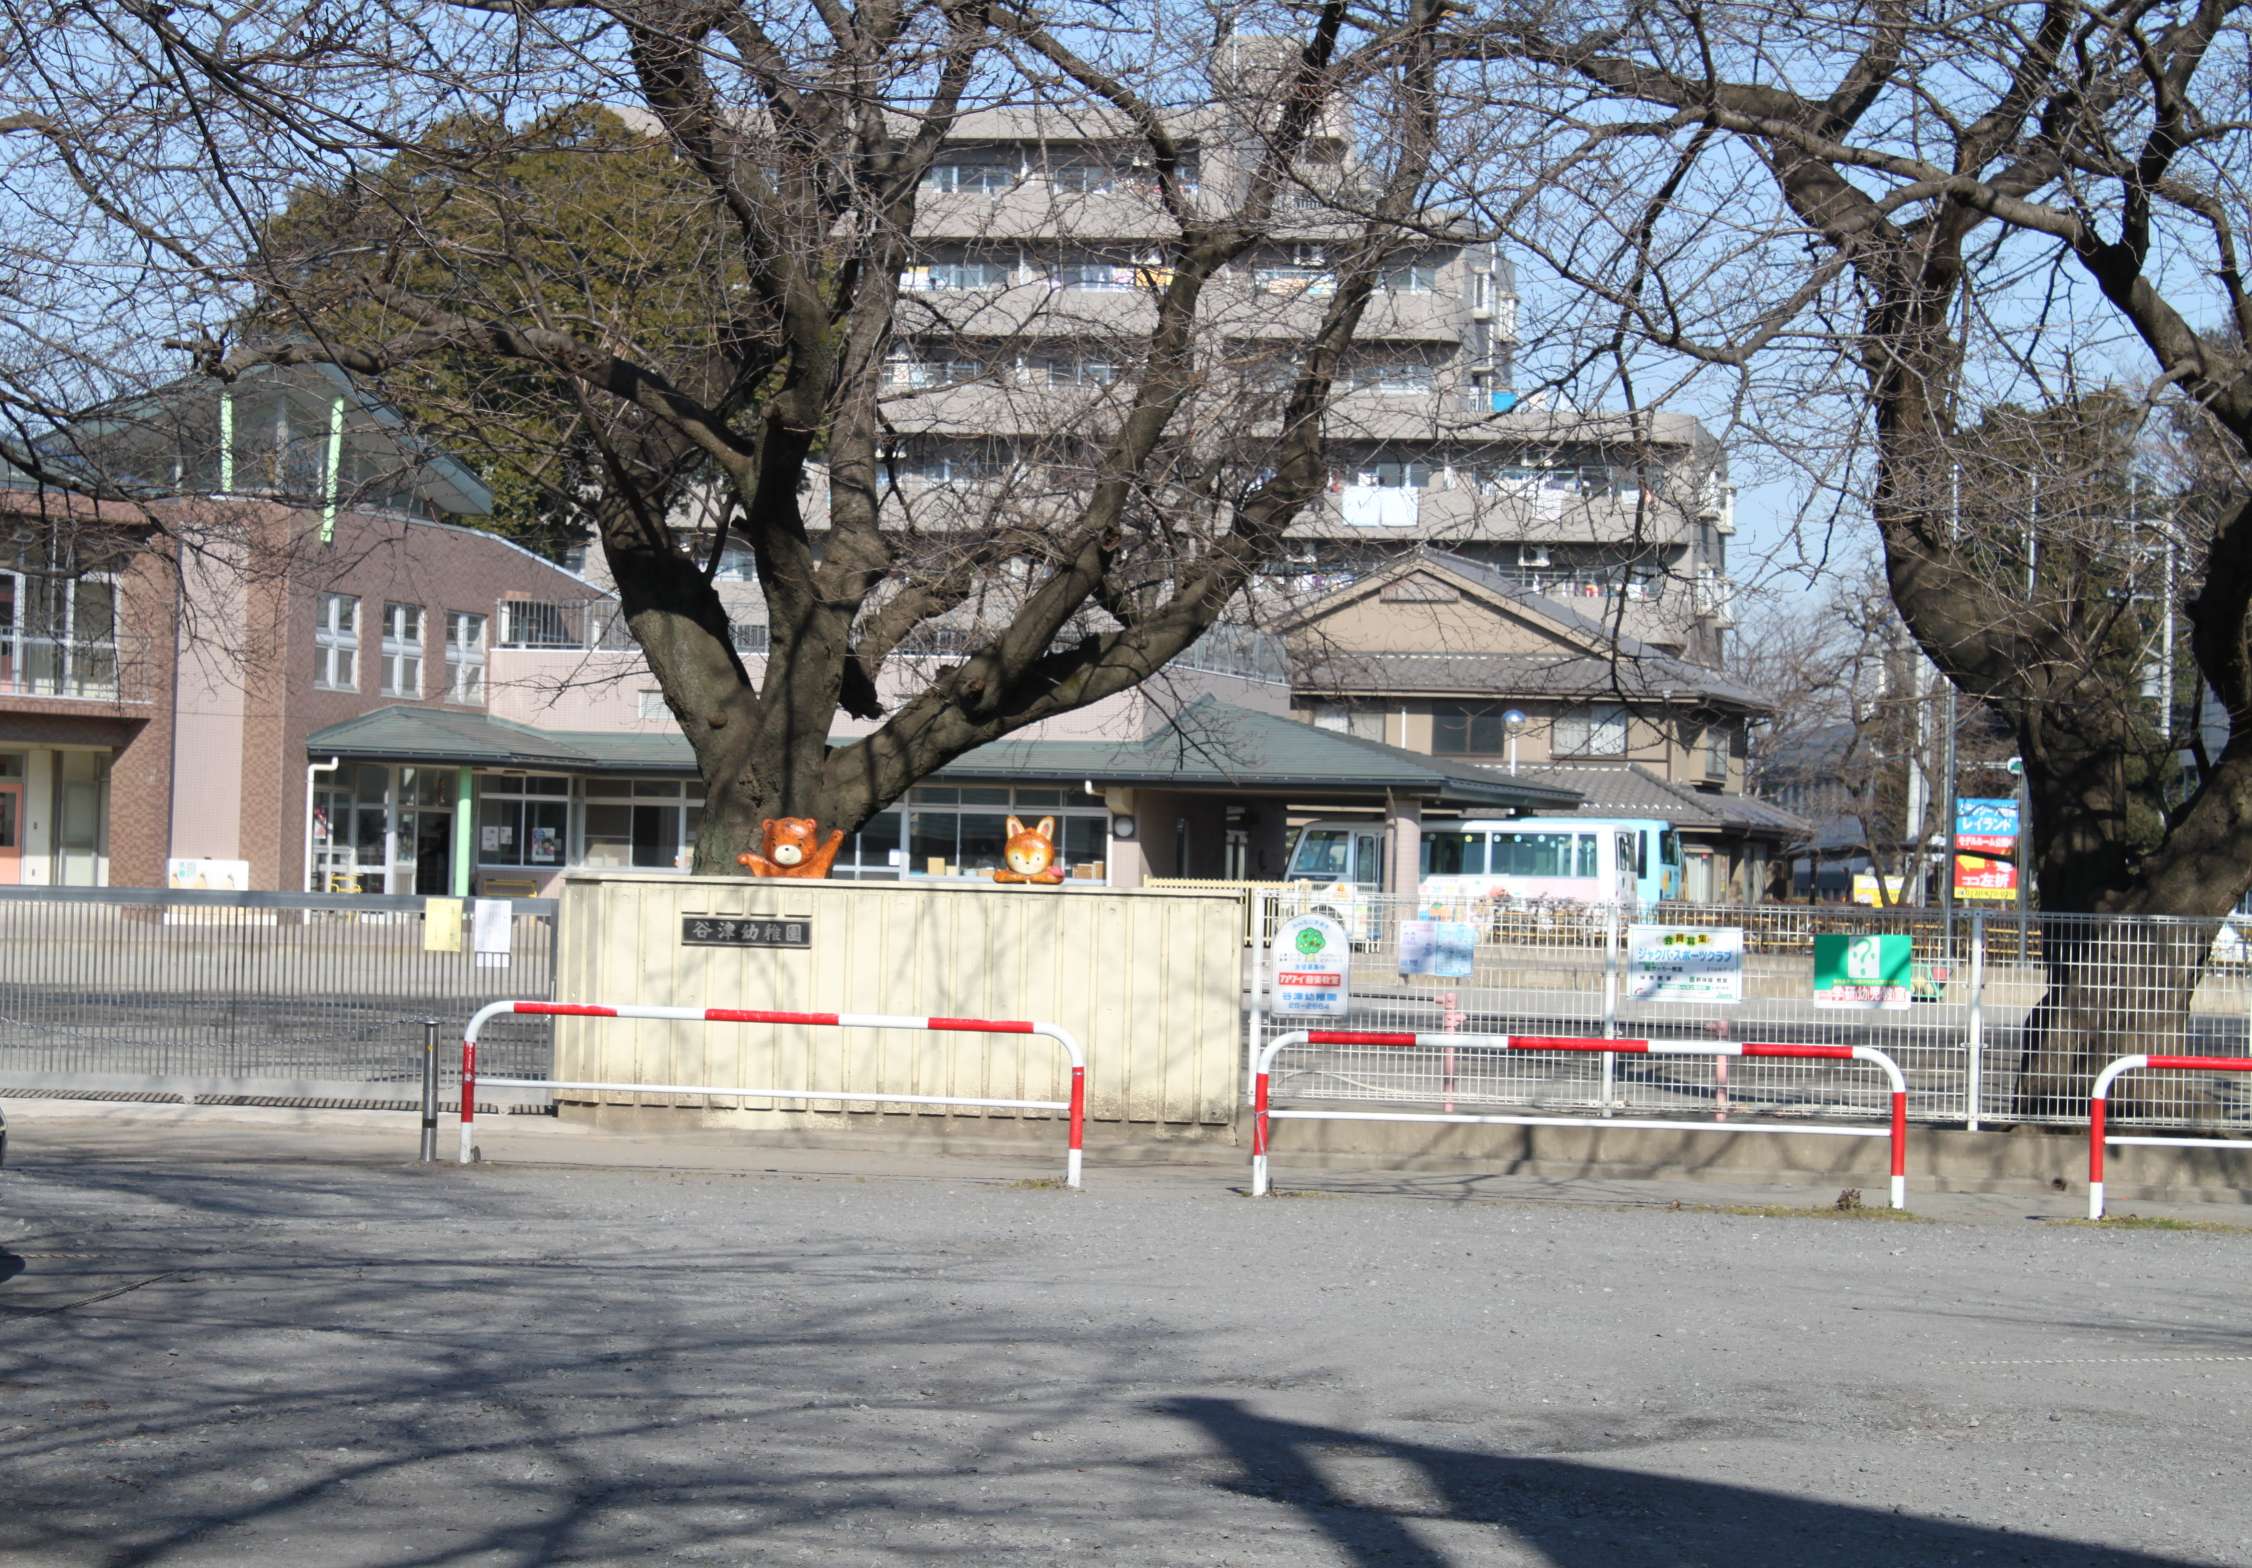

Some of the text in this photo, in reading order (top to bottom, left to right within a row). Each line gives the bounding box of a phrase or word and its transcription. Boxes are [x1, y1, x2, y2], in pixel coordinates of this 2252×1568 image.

[692, 921, 802, 942] 谷津幼稚園
